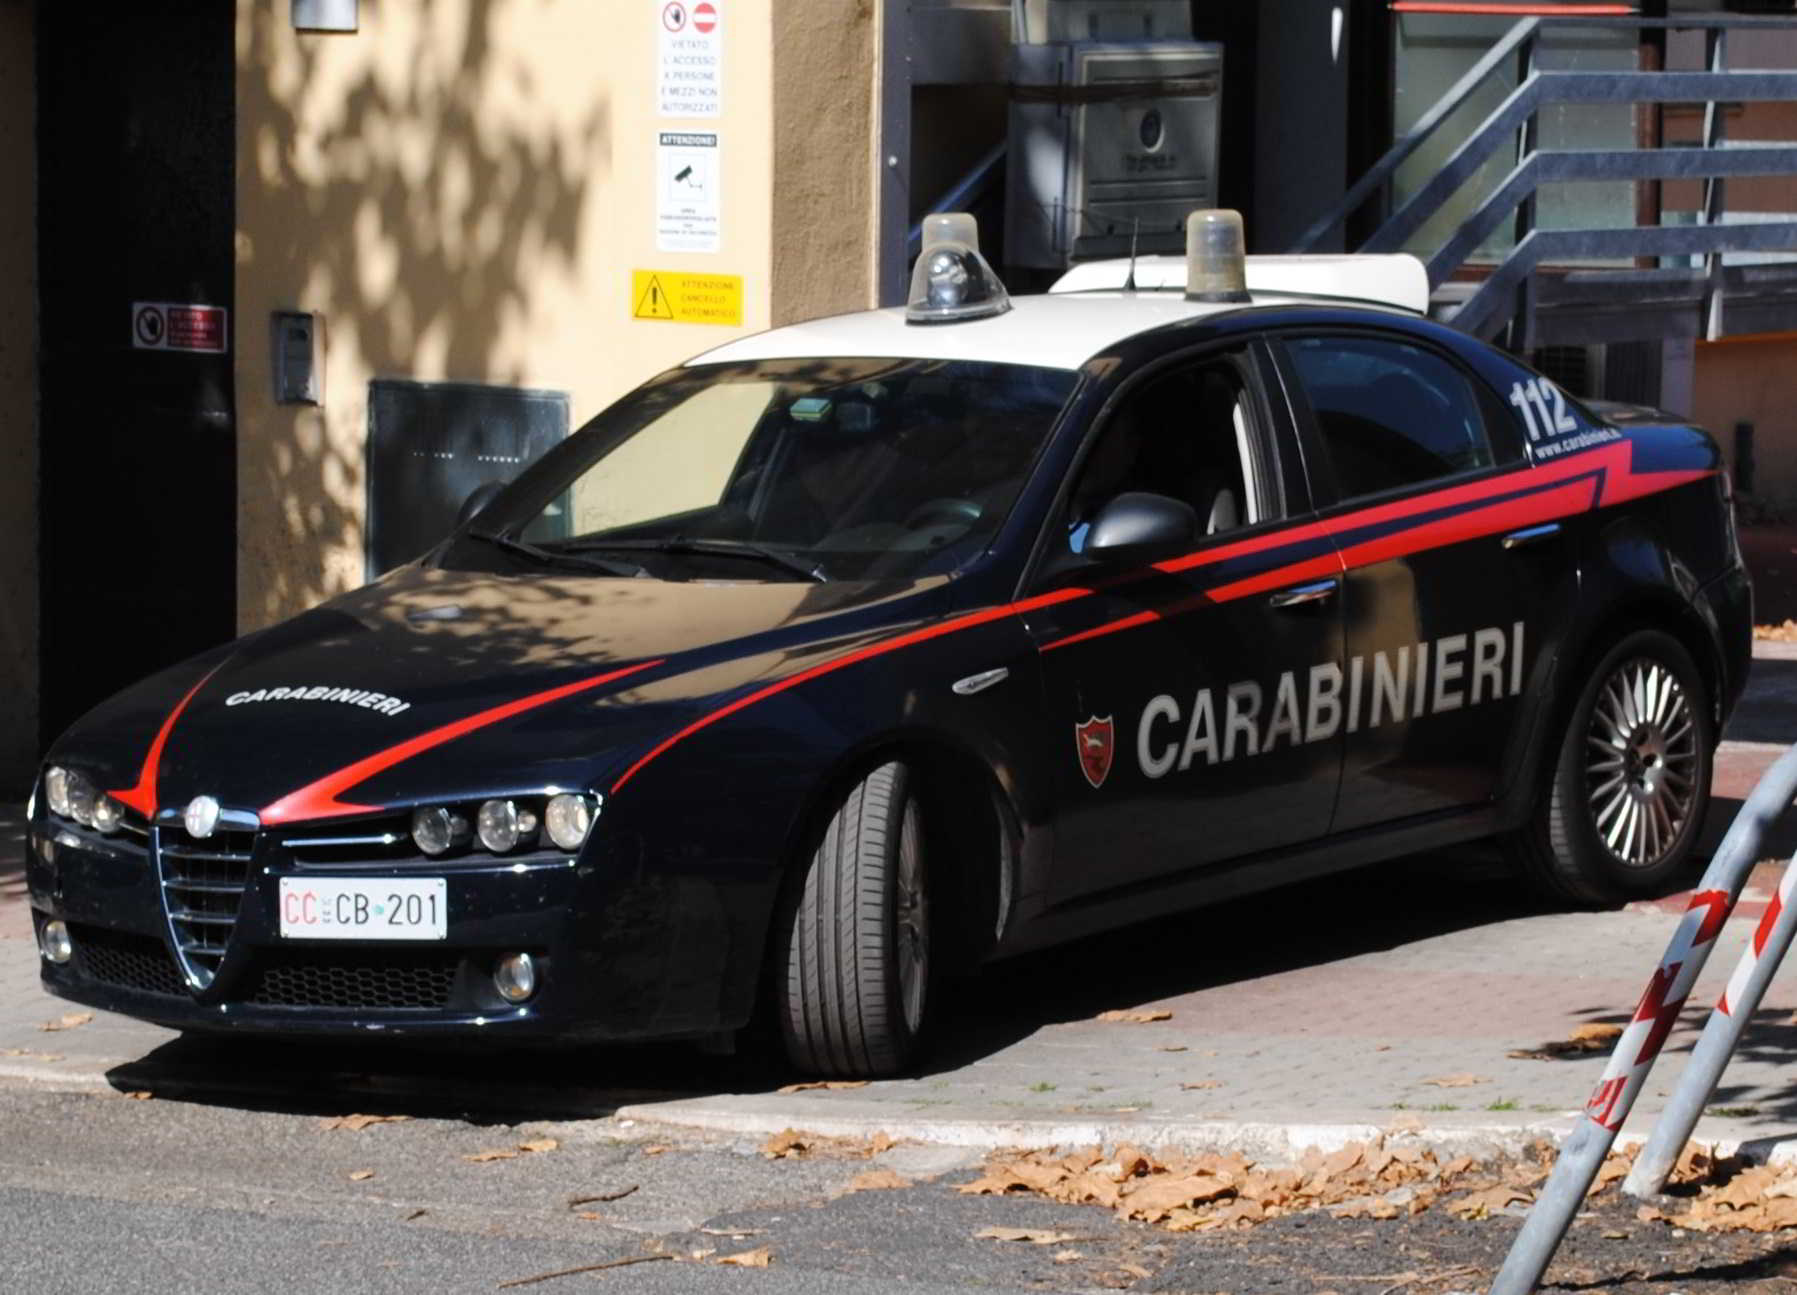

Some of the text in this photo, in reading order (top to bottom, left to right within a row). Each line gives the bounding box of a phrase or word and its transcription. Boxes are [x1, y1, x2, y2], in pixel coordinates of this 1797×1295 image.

[671, 39, 709, 49] VIETATO
[698, 87, 718, 97] NON
[1509, 375, 1578, 442] 112
[225, 685, 411, 717] CARABINIERI
[1137, 621, 1525, 780] CARABINIERI
[284, 892, 317, 925] CC
[336, 892, 370, 925] CB
[387, 893, 437, 926] 201
